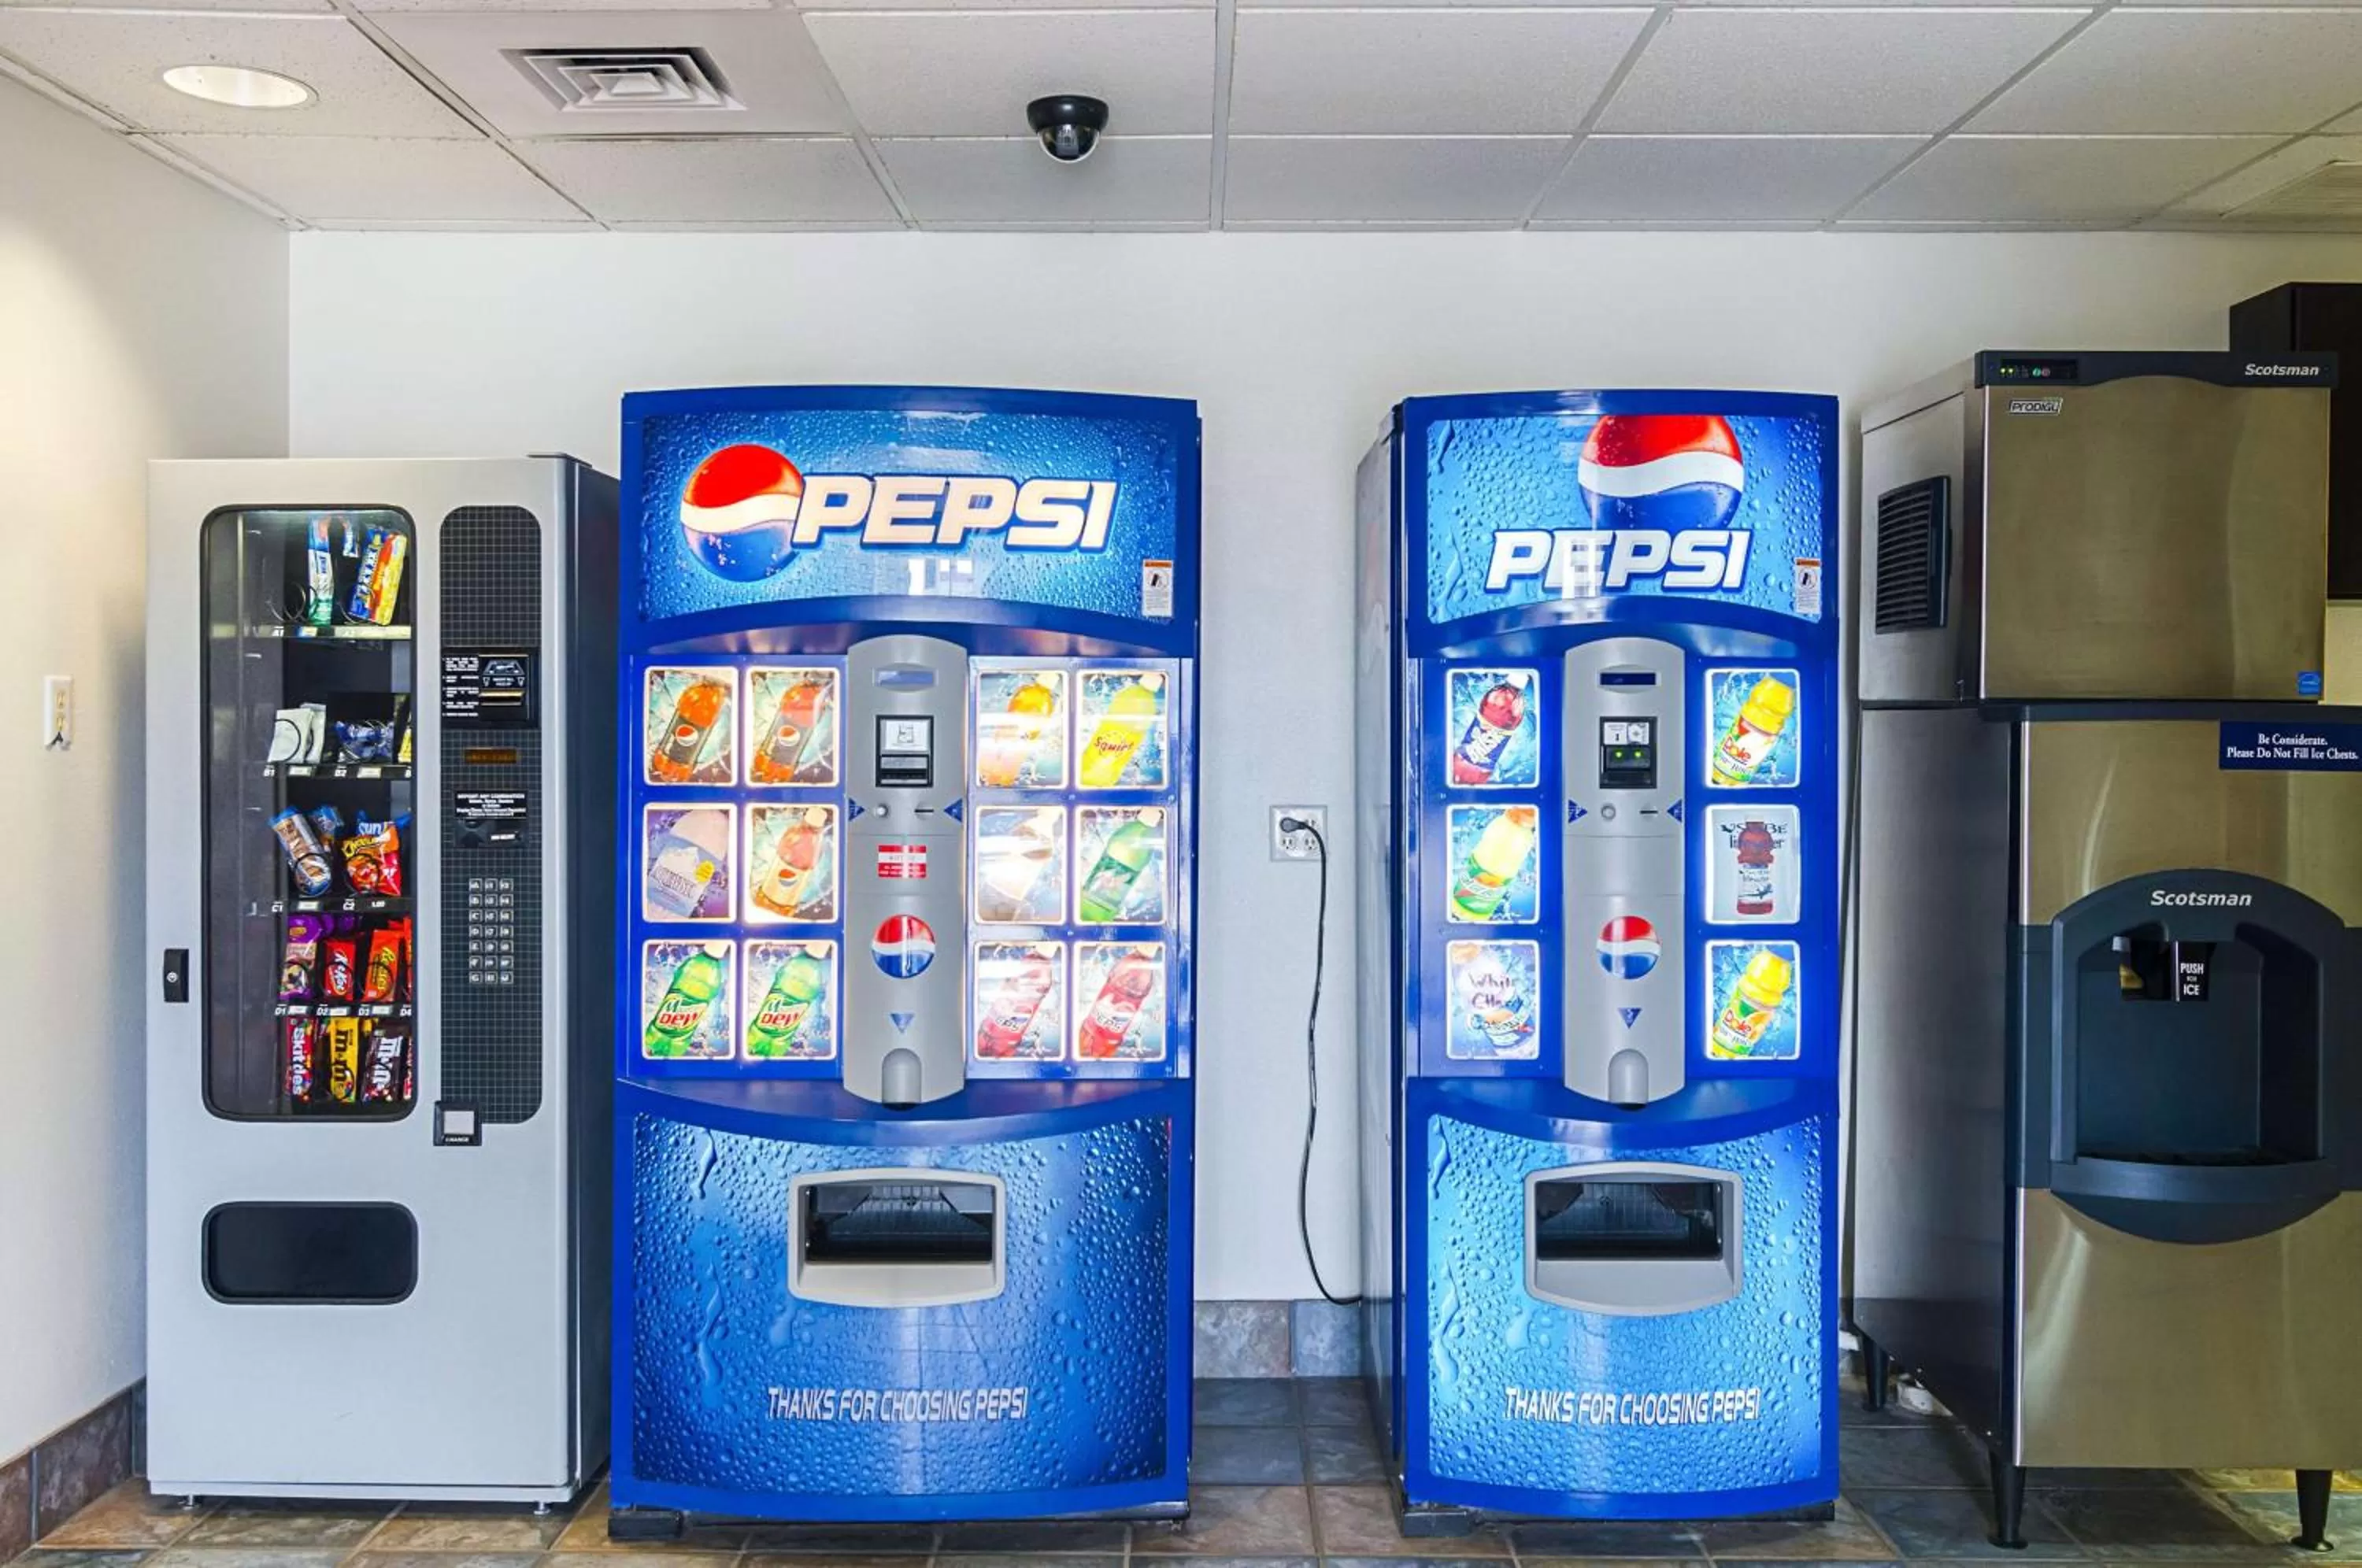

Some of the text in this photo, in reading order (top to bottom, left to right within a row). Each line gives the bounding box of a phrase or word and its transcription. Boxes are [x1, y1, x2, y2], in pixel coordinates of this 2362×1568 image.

[2245, 363, 2319, 375] Scotsman
[791, 475, 1116, 549] PEPSI
[1486, 531, 1750, 589] PEPSI
[2258, 733, 2328, 745] Be Considerate.
[2227, 747, 2359, 760] Please Do Not Fill Ice Chests.
[2150, 889, 2253, 906] Scotsman
[2180, 963, 2204, 974] PUSH
[2183, 984, 2200, 996] ICE
[768, 1386, 1029, 1422] THANKS FOR CHOOSING PEPSI
[1505, 1387, 1761, 1426] THANKS FOR CHOOSING PEPSI
